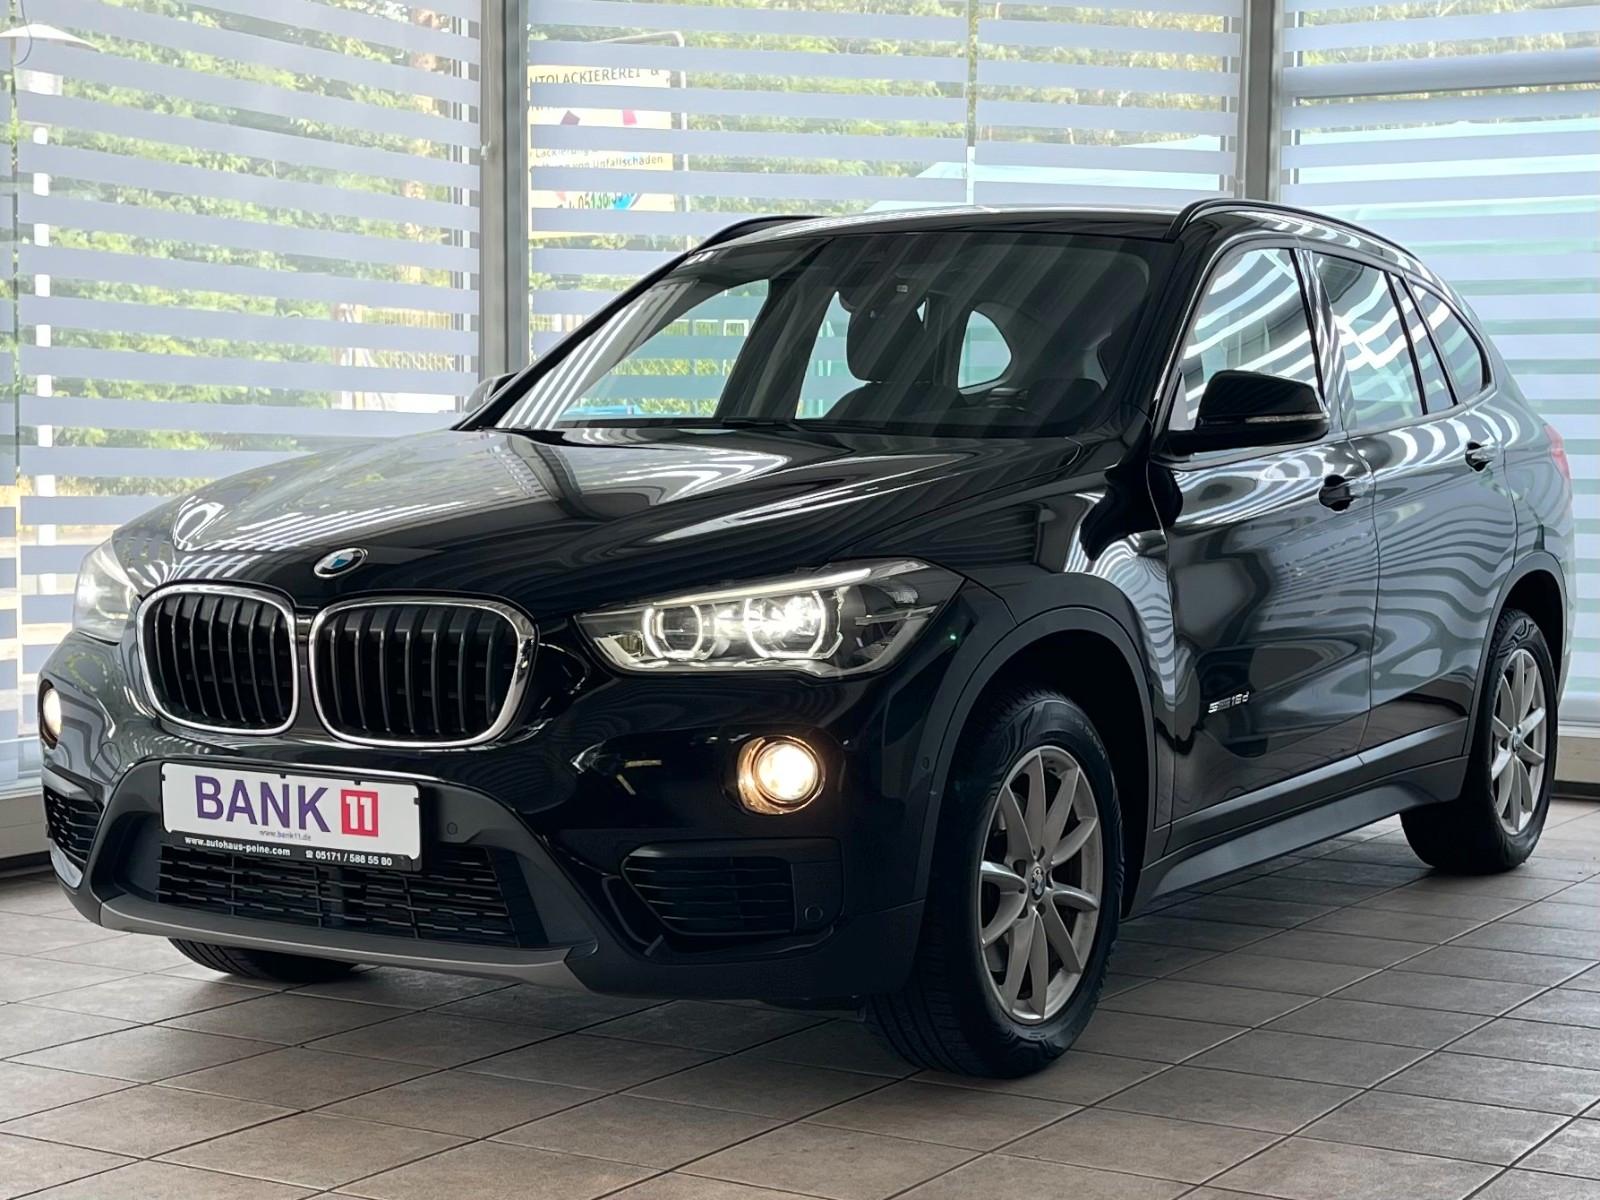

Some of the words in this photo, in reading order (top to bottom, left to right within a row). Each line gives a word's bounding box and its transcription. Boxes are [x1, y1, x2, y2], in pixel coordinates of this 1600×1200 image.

[195, 775, 331, 833] BANK
[184, 836, 290, 856] www.autohaus-peine.com
[315, 850, 340, 860] 05171
[349, 853, 366, 864] 588
[367, 855, 379, 864] 55
[381, 856, 392, 866] 80
